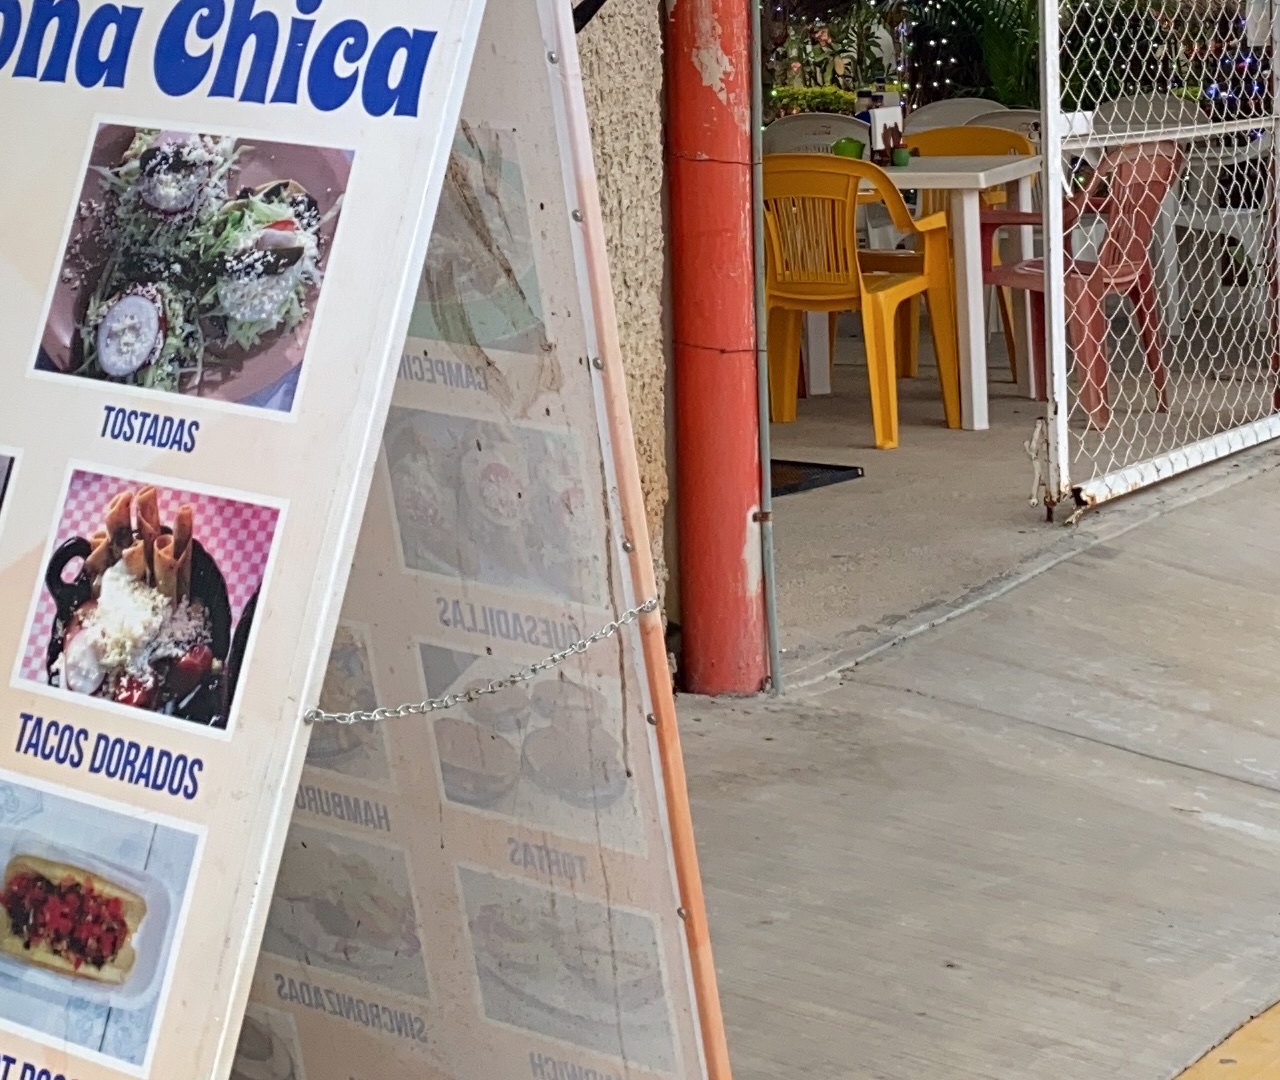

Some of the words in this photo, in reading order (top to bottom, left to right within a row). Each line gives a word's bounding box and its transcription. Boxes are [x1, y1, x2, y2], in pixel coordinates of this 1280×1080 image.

[100, 406, 200, 454] TOSTADAS
[14, 713, 84, 774] TACOS
[89, 732, 204, 801] DORADOS
